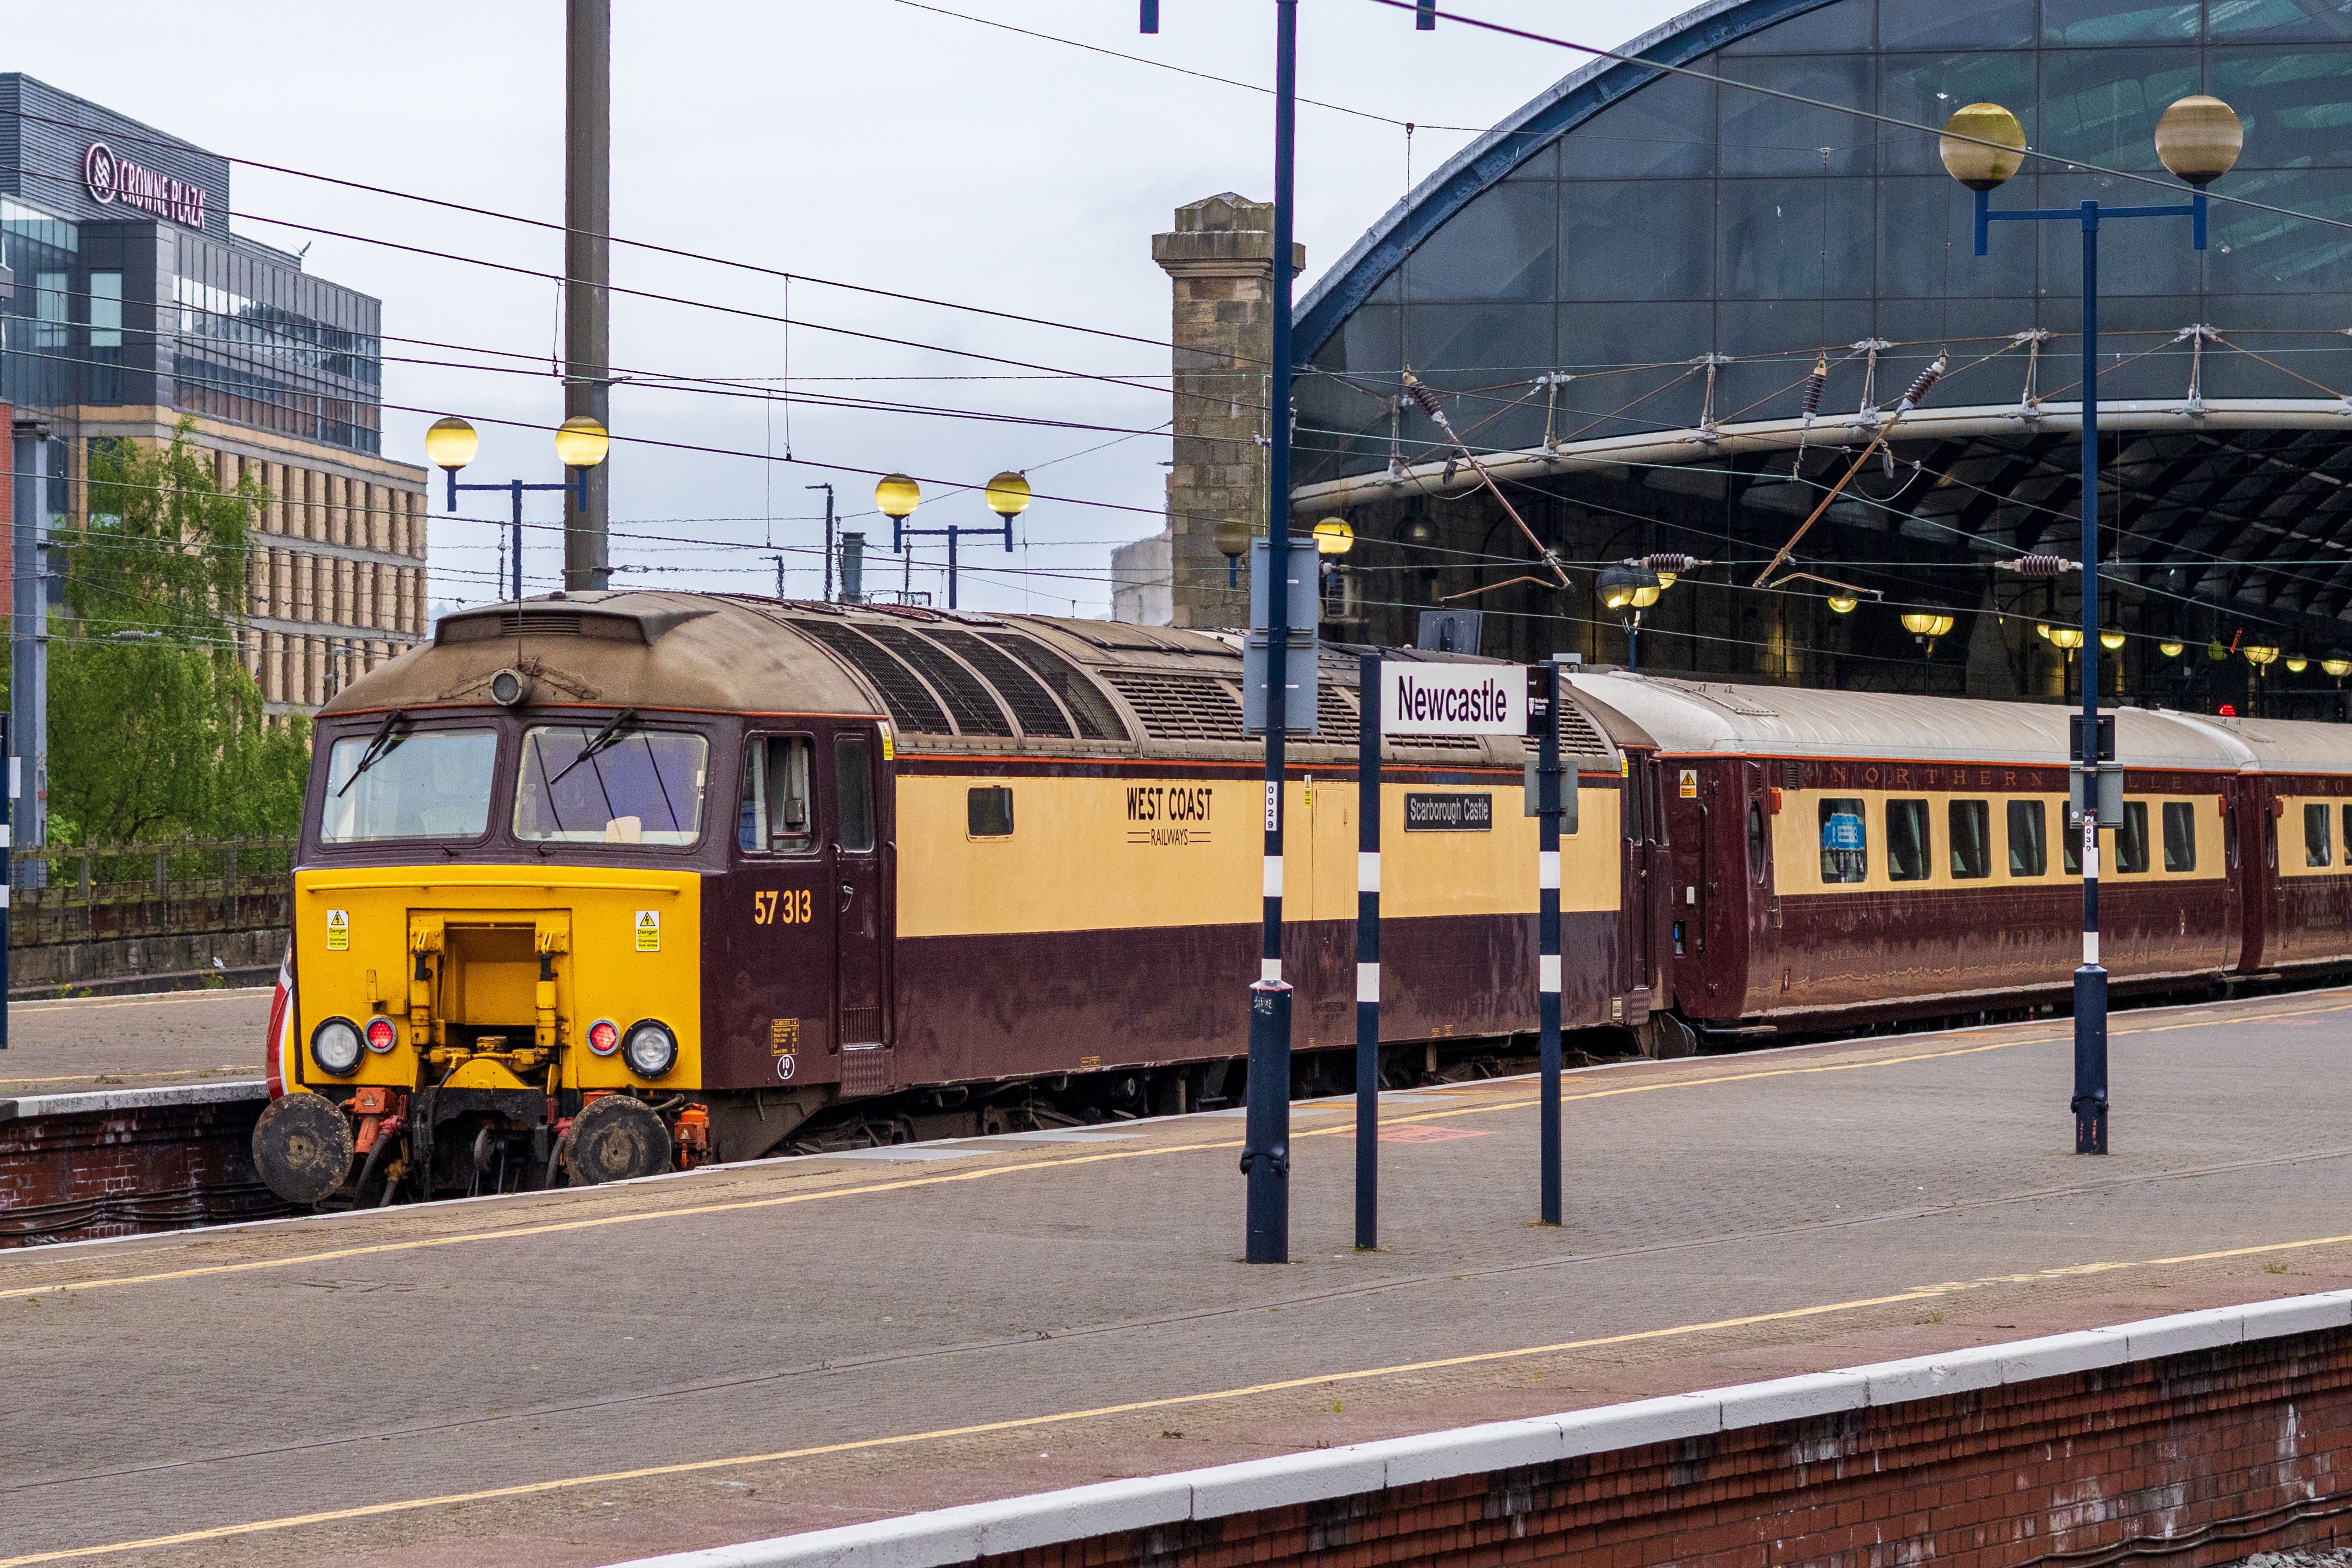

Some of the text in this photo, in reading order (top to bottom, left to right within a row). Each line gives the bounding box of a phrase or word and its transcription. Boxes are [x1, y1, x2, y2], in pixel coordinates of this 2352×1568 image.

[119, 160, 205, 229] CROWNE PLAZA
[1398, 675, 1507, 723] Newcastle
[1833, 767, 2042, 786] NORTHERN
[1127, 787, 1212, 821] WEST COAST
[1410, 797, 1488, 825] Scarborough Castle
[1151, 828, 1188, 845] RAILWAYS
[755, 890, 812, 924] 57 313
[1821, 948, 1882, 961] PULLMAN
[782, 1058, 790, 1069] 10
